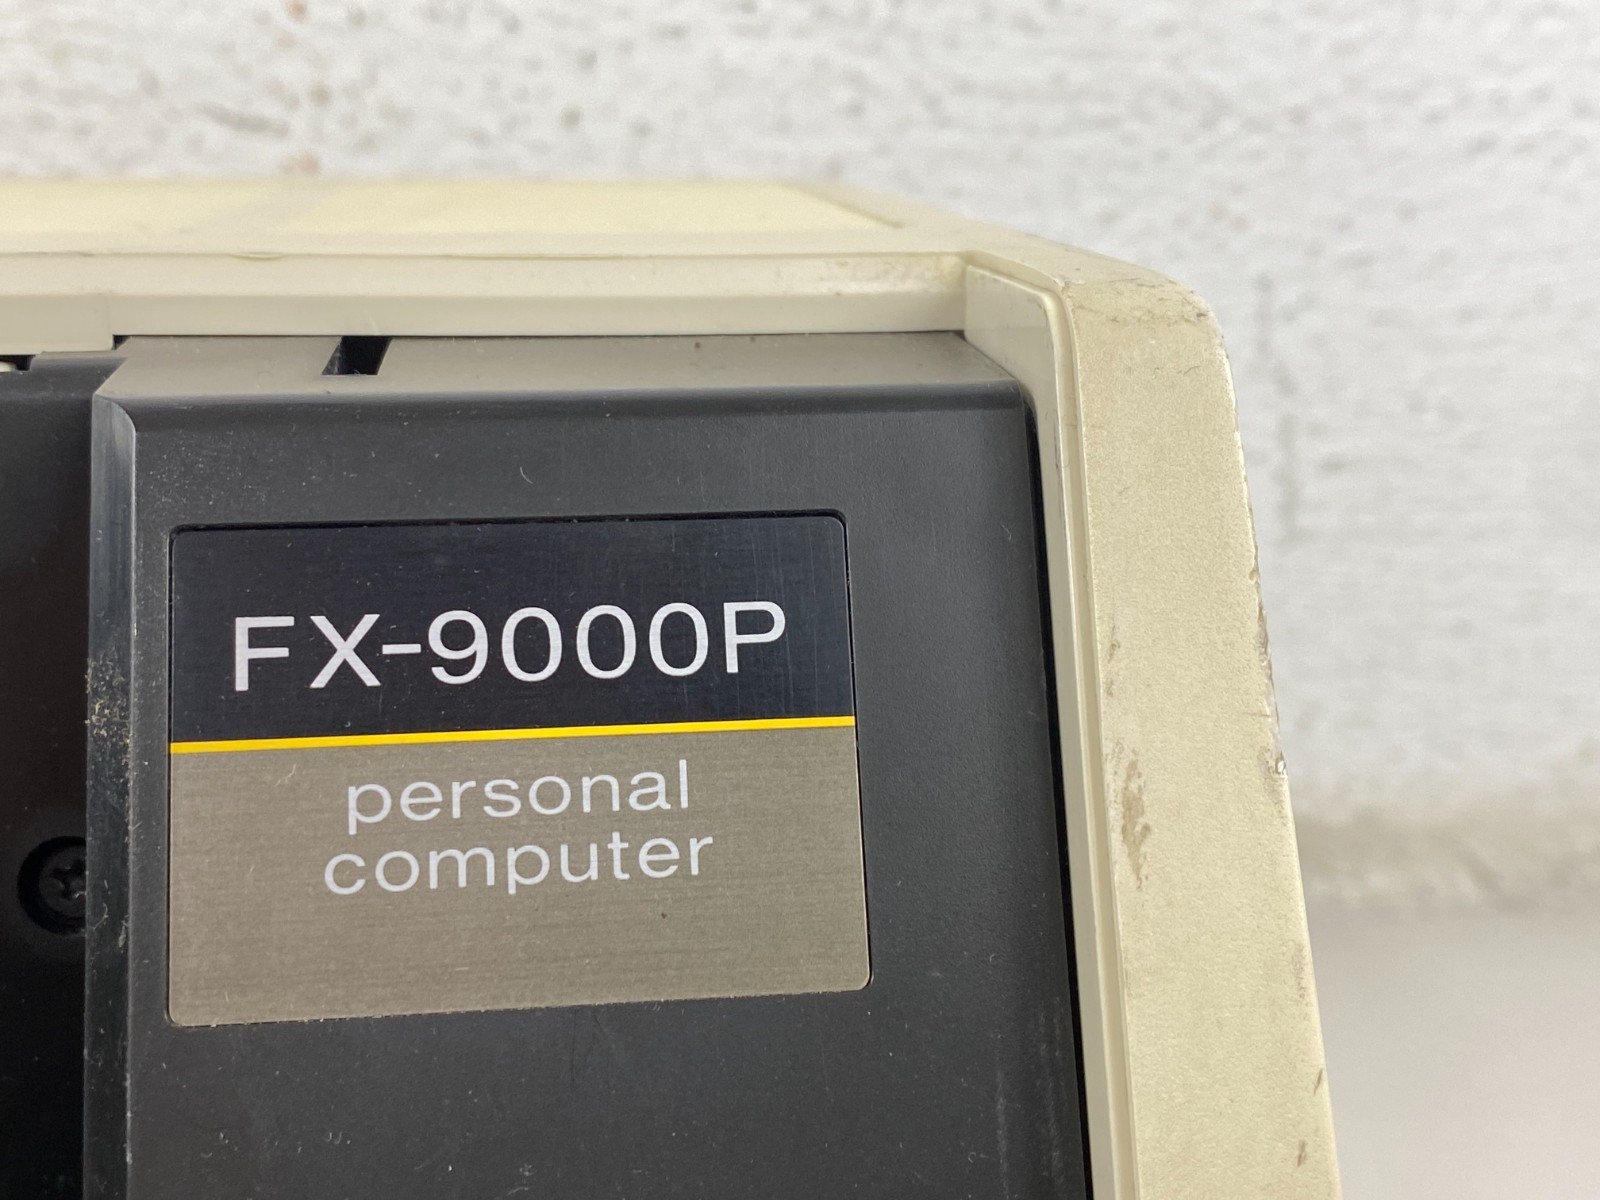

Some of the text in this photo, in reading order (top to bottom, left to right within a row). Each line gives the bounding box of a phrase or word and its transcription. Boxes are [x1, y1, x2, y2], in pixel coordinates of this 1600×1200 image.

[234, 601, 787, 693] FX-9000P
[347, 758, 690, 836] personal
[323, 830, 714, 897] computer
